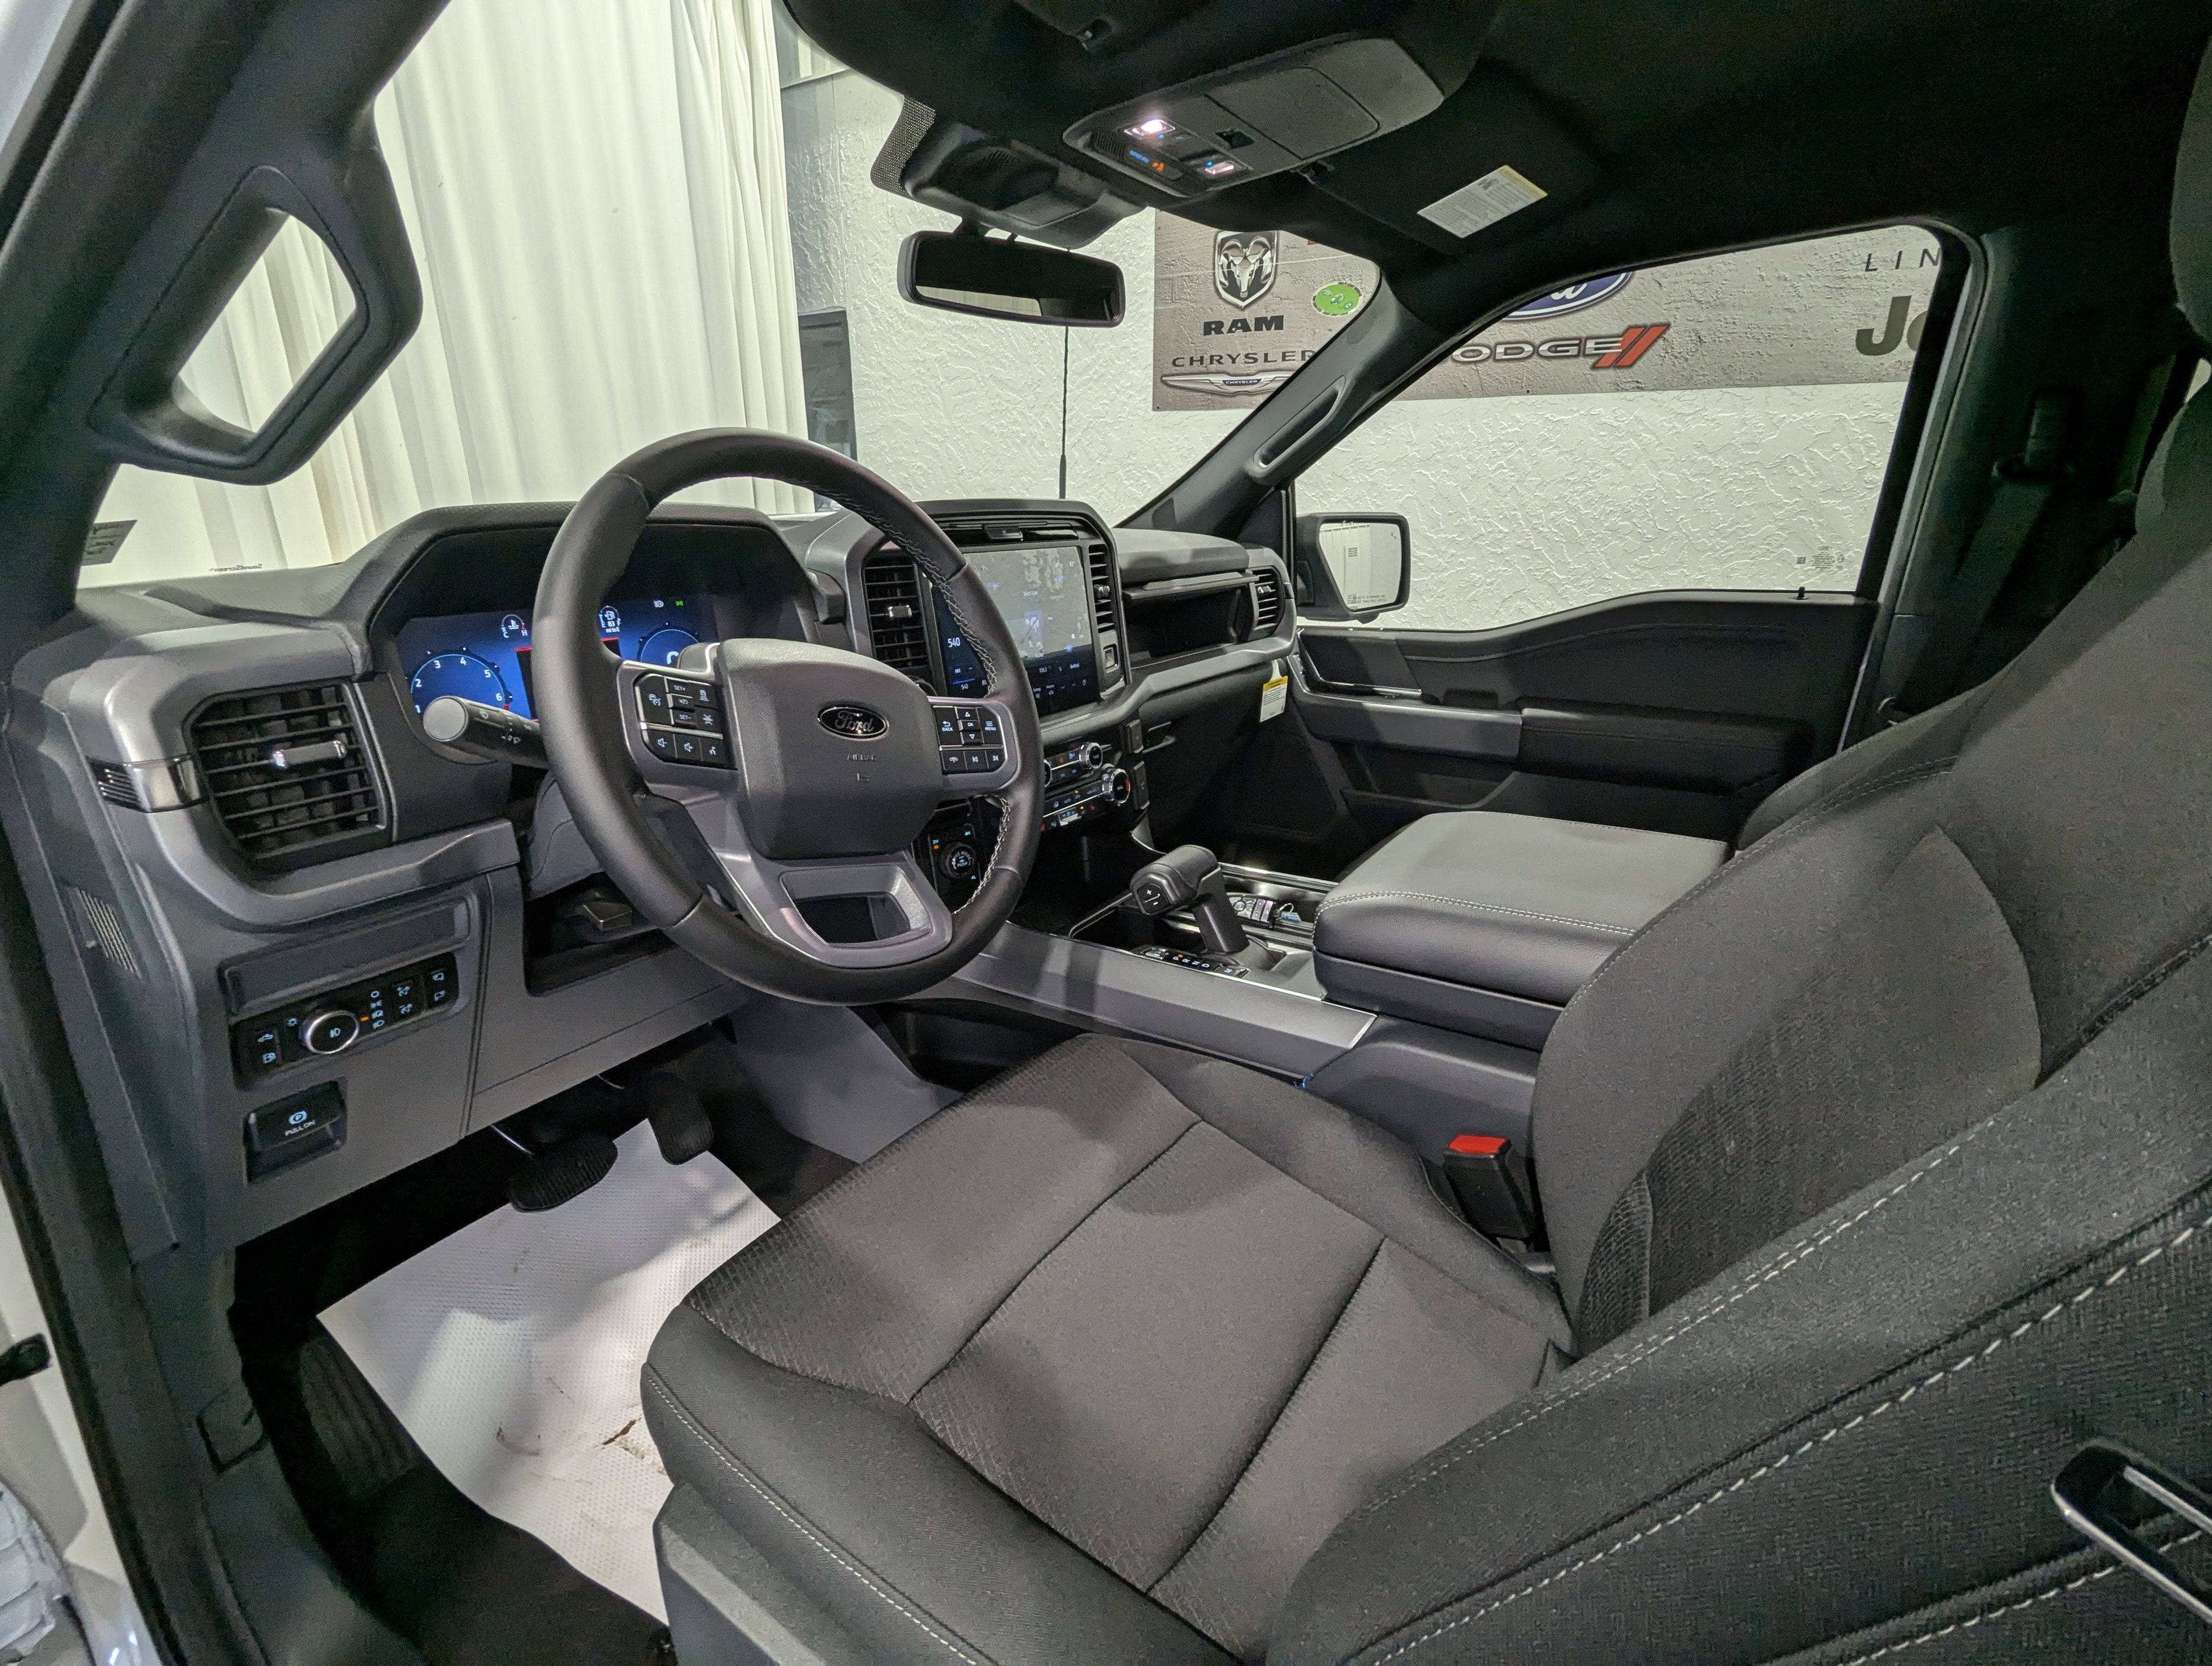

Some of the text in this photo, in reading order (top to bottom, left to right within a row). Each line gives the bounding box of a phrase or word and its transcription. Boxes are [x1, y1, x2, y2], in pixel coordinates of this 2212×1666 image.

[1864, 247, 1942, 272] LIN
[1203, 315, 1284, 336] RAM
[947, 637, 961, 648] 540
[434, 660, 441, 669] 3
[460, 657, 467, 665] 4
[484, 669, 491, 678] 5
[415, 678, 422, 688] 2
[496, 693, 503, 701] 6
[415, 704, 421, 714] 1
[834, 710, 874, 732] Ford
[285, 1120, 316, 1136] PULL ON
